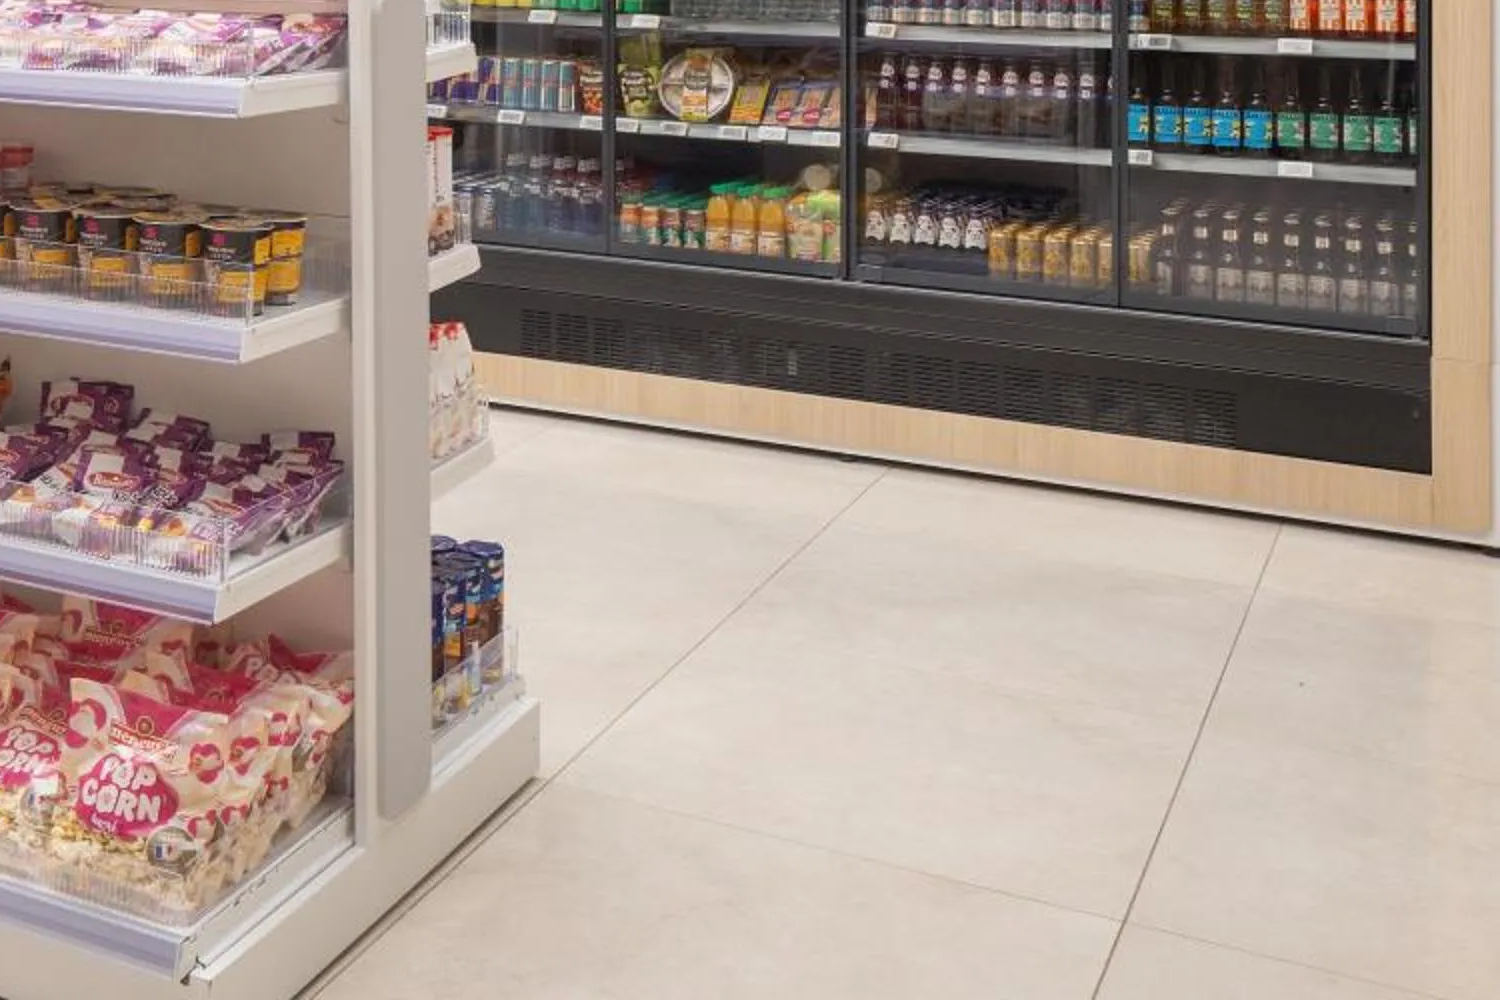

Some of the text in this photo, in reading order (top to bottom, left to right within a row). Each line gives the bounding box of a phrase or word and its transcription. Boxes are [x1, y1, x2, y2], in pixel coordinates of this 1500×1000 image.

[3, 727, 54, 753] POP
[101, 754, 157, 790] POP
[82, 778, 162, 823] CORN
